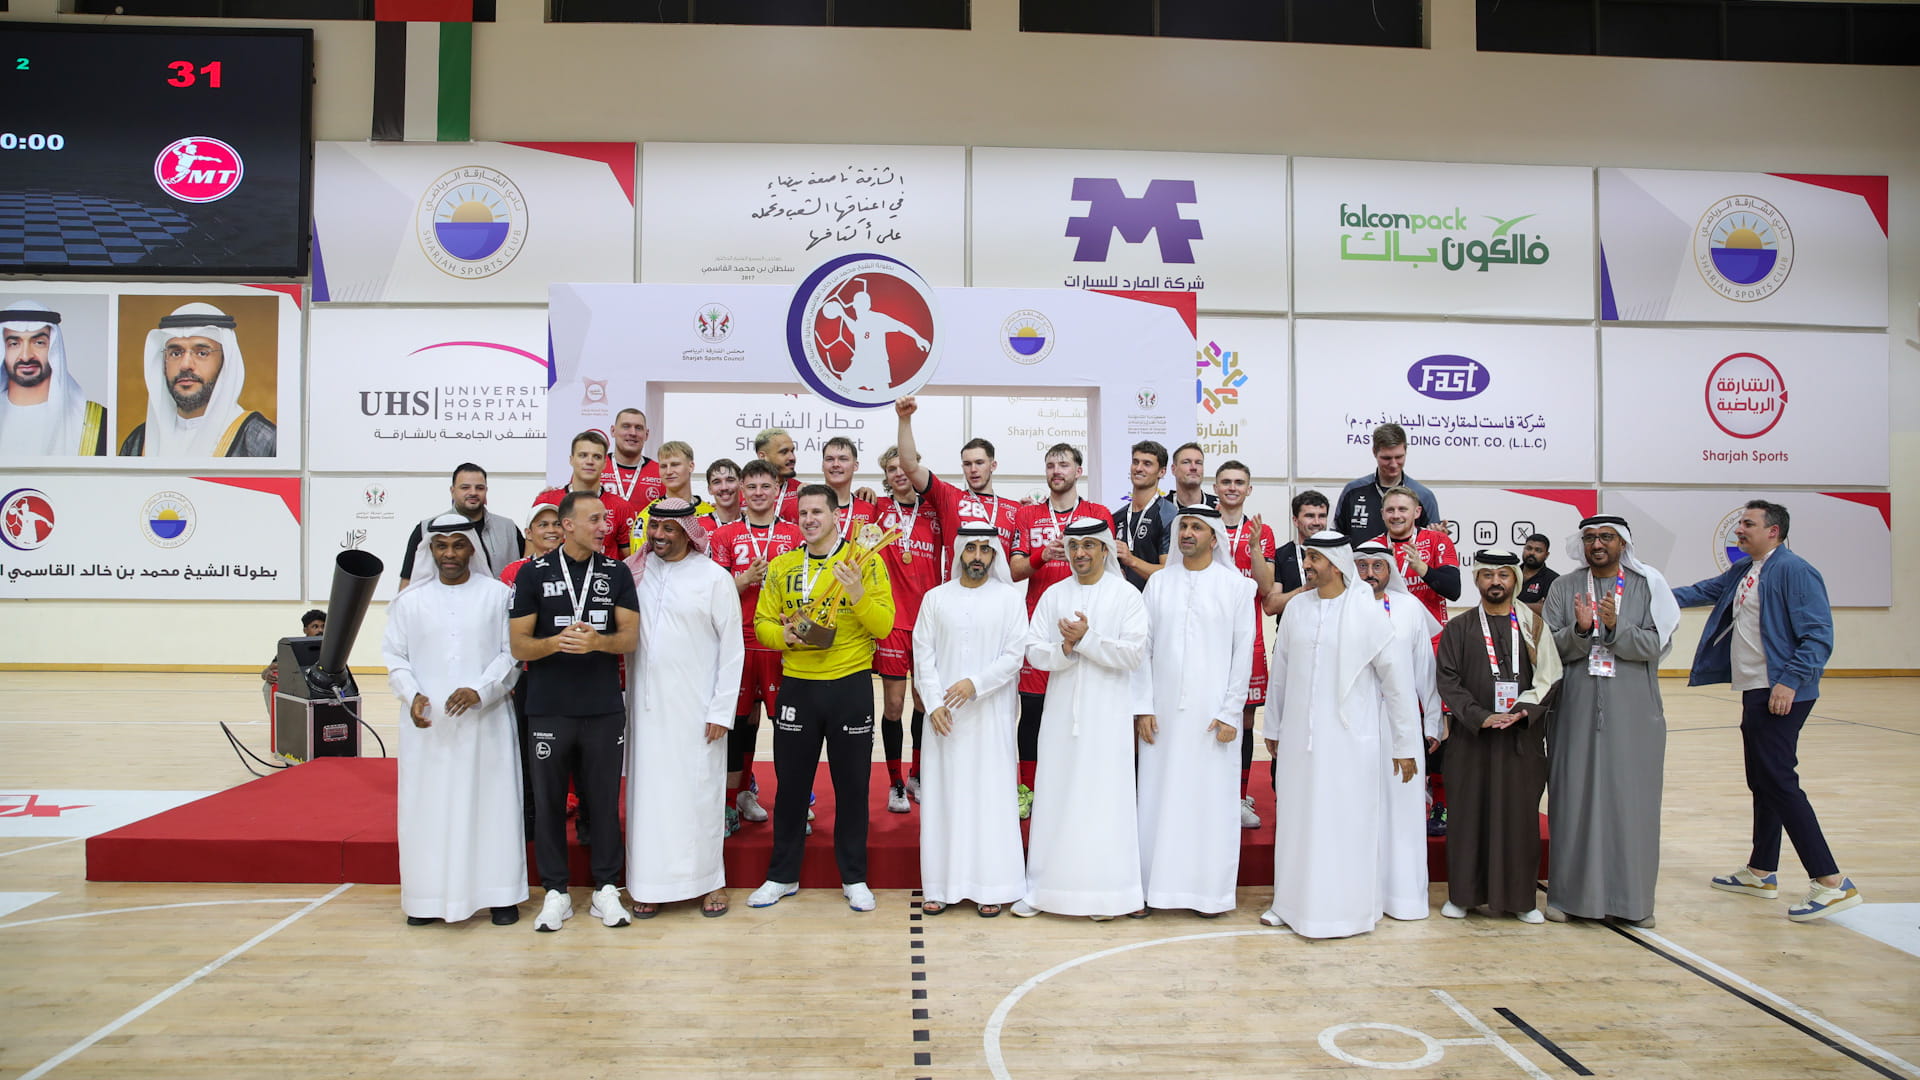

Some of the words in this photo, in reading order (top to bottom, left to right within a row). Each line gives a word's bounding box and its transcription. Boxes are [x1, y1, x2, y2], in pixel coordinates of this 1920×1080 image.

[16, 57, 30, 70] 2
[167, 60, 222, 88] 31
[0, 133, 65, 150] 0:00
[188, 170, 236, 184] MT
[463, 169, 508, 188] الشارقة
[1734, 198, 1775, 218] الشارقة
[1340, 203, 1467, 234] falconpack
[423, 230, 457, 272] SHARJAH
[460, 257, 504, 276] SPORTS
[504, 229, 522, 258] CLUB
[1442, 233, 1550, 273] فالكون
[1123, 276, 1159, 291] المارد
[1164, 275, 1204, 291] شركة
[1700, 254, 1732, 295] SHARJAH
[1735, 282, 1773, 299] SPORTS
[1773, 256, 1788, 283] CLUB
[864, 331, 870, 340] 8
[445, 386, 549, 396] UNIVERSIT
[1717, 378, 1774, 395] الشارقة
[359, 391, 430, 417] UHS
[444, 398, 539, 408] HOSPITAL
[1717, 397, 1774, 414] الرياضية
[444, 411, 532, 421] SHARJAH
[736, 411, 811, 429] الشارقة
[817, 411, 865, 432] مطار
[1479, 415, 1515, 428] فاست
[1517, 414, 1546, 432] شركة
[374, 427, 437, 441] بالشارقة
[440, 428, 492, 441] الجامعة
[1007, 426, 1044, 438] Sharjah
[1047, 427, 1087, 437] Comme
[1196, 420, 1239, 440] الشارق
[1200, 440, 1238, 456] arjah
[1347, 434, 1374, 445] FAS
[1406, 435, 1441, 446] DING
[1444, 436, 1480, 447] CONT.
[1484, 437, 1505, 447] CO.
[1509, 437, 1547, 450] (L.L.C)
[1702, 450, 1748, 464] Sharjah
[1752, 450, 1789, 464] Sports
[1353, 505, 1369, 517] FL
[1030, 527, 1056, 548] 53
[1480, 528, 1492, 539] in
[8, 564, 75, 583] القاسمي
[79, 564, 112, 577] خالد
[116, 565, 135, 580] بن
[140, 567, 180, 578] محمد
[183, 564, 229, 580] الشيخ
[234, 565, 278, 581] بطولة
[542, 581, 567, 597] RP
[780, 705, 797, 721] 16
